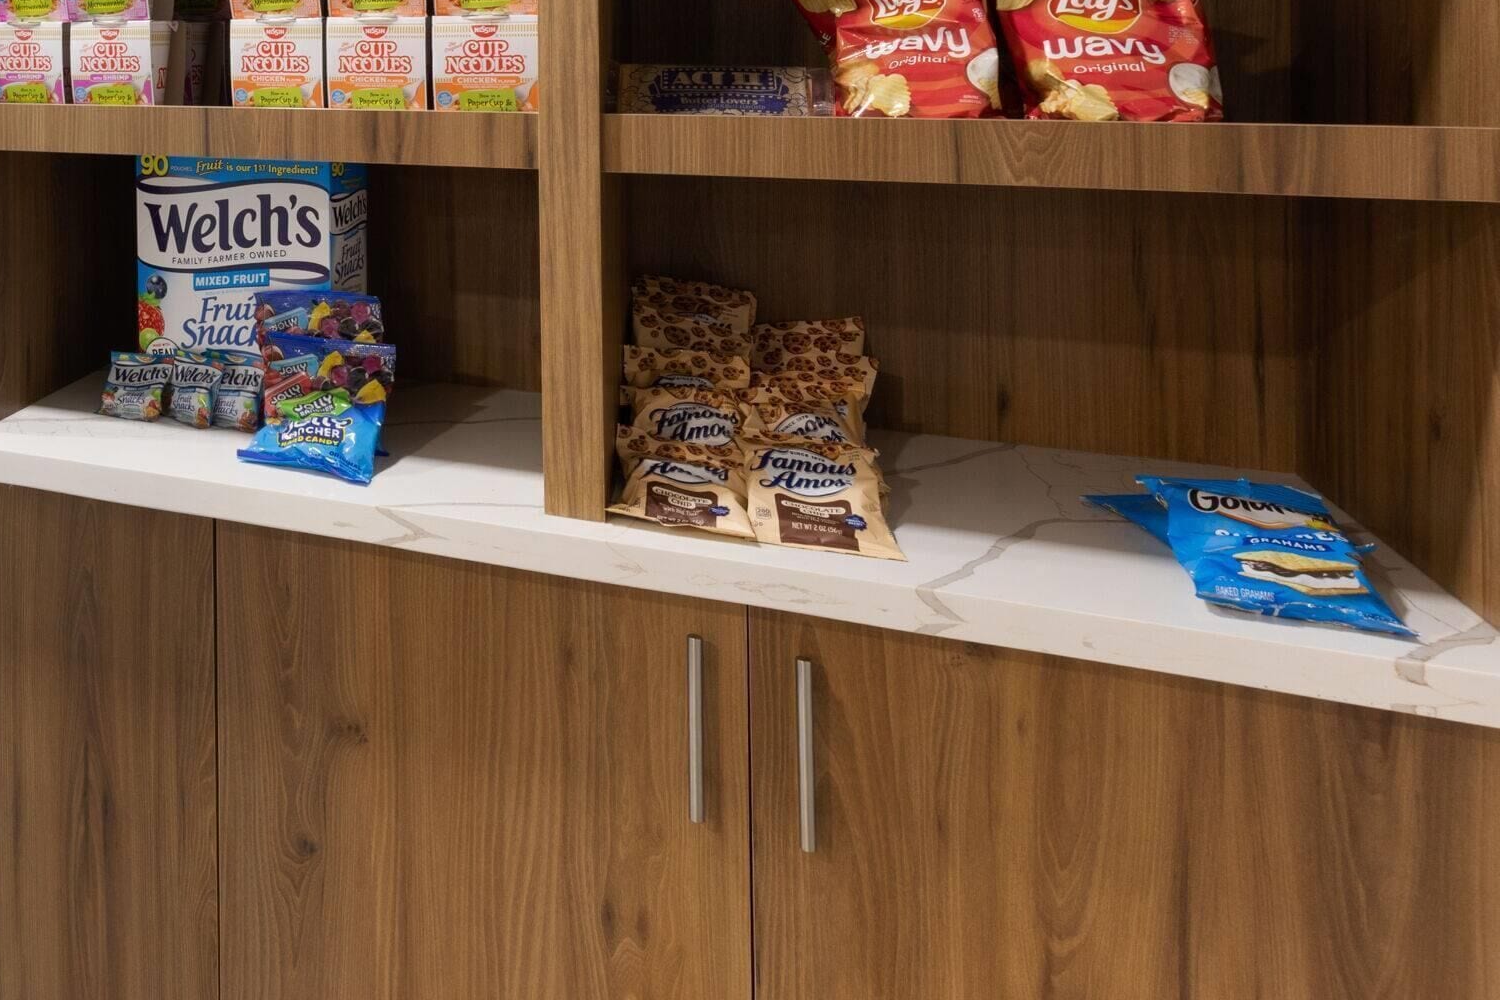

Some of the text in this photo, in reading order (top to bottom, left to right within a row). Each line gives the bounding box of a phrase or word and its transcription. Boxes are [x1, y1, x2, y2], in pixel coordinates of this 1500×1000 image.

[9, 43, 40, 58] CUP
[93, 43, 127, 58] CUP
[257, 41, 295, 57] CUP
[355, 41, 397, 57] CUP
[463, 40, 509, 57] CUP
[1043, 36, 1166, 64] wavy
[81, 55, 140, 72] NOODLES
[242, 56, 309, 73] NOODLES
[339, 55, 412, 73] NOODLES
[445, 55, 525, 74] NOODLES
[889, 55, 946, 69] Original
[1073, 62, 1146, 74] Original
[673, 72, 761, 85] ACT II
[140, 154, 168, 176] 90
[196, 160, 223, 173] Fruit
[227, 163, 233, 171] is
[236, 164, 250, 172] our
[269, 165, 318, 175] Ingredient!
[332, 194, 367, 227] Welch's
[144, 193, 321, 253] Welch's
[172, 250, 286, 265] FAMILY FARMER OWNED
[341, 241, 362, 262] Fruit
[335, 257, 364, 283] Snacks
[195, 273, 266, 286] MIXED FRUIT
[201, 296, 256, 323] Frui
[115, 367, 170, 382] Welch's
[174, 364, 216, 384] Welch's
[280, 362, 308, 375] JOLLY
[220, 370, 261, 386] elch's
[271, 385, 300, 404] JOLLY
[294, 395, 333, 413] JOLLY
[649, 408, 738, 435] Famous
[305, 436, 339, 446] CANDY
[750, 448, 856, 475] Famous
[759, 471, 848, 488] Amos
[655, 488, 709, 503] CHOCOLATE
[783, 501, 840, 513] CHOCOLATE
[1250, 537, 1326, 551] GRAHAMS
[1215, 585, 1239, 598] BAKED
